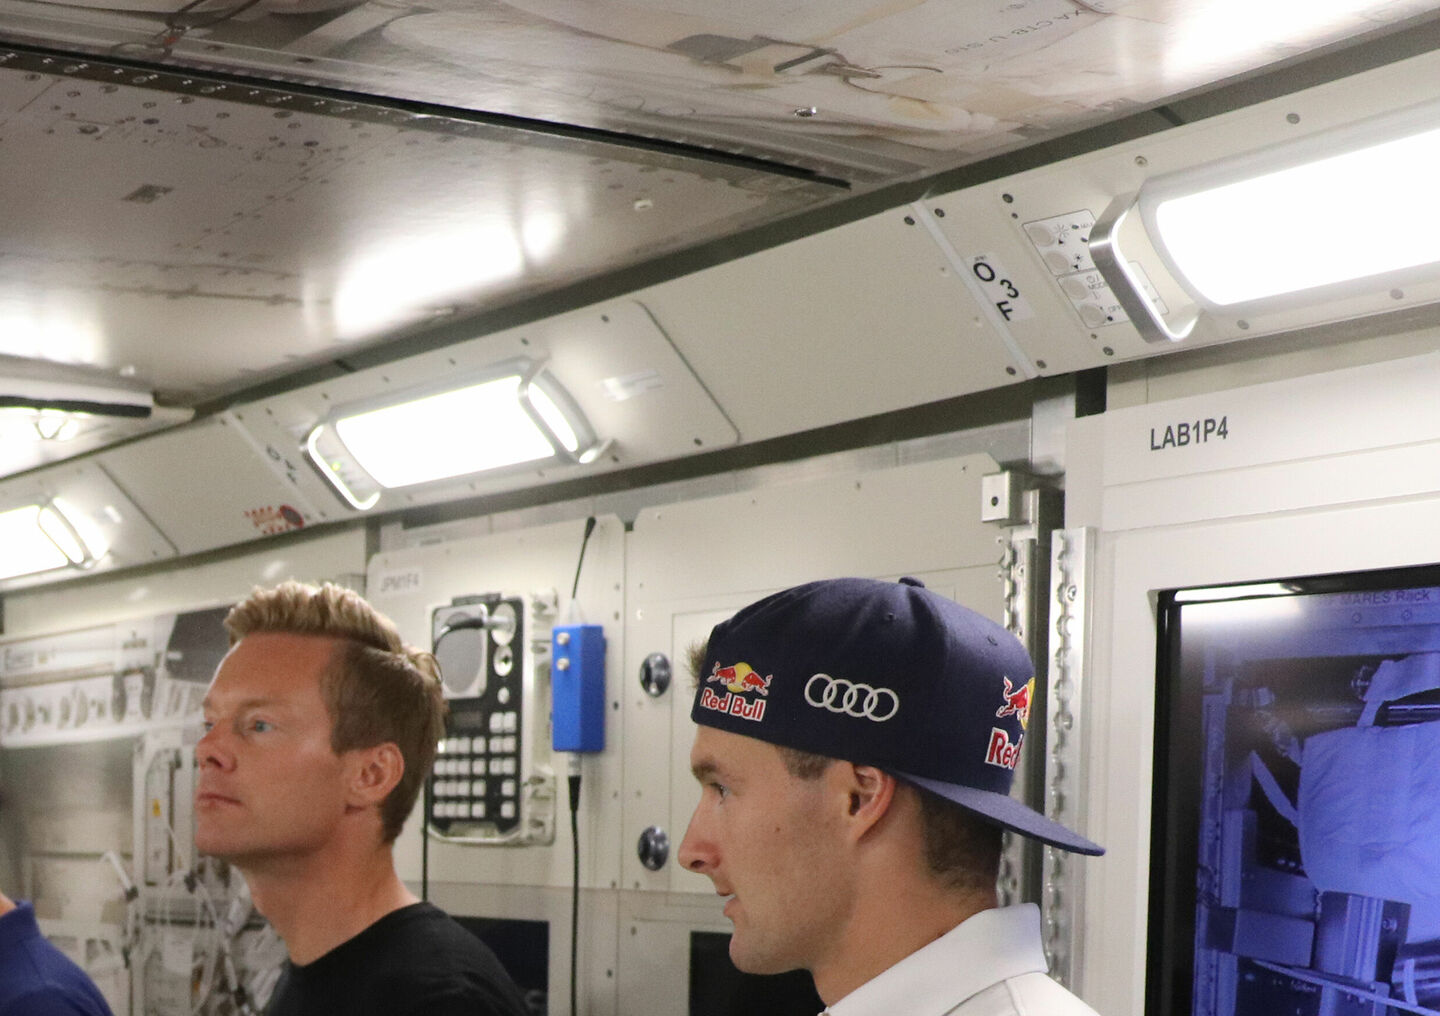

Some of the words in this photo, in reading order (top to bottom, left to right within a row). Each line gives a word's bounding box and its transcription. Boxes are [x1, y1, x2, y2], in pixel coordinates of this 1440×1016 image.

[1150, 416, 1228, 451] LAB1P4
[700, 687, 732, 713] Red
[729, 695, 766, 722] Bull
